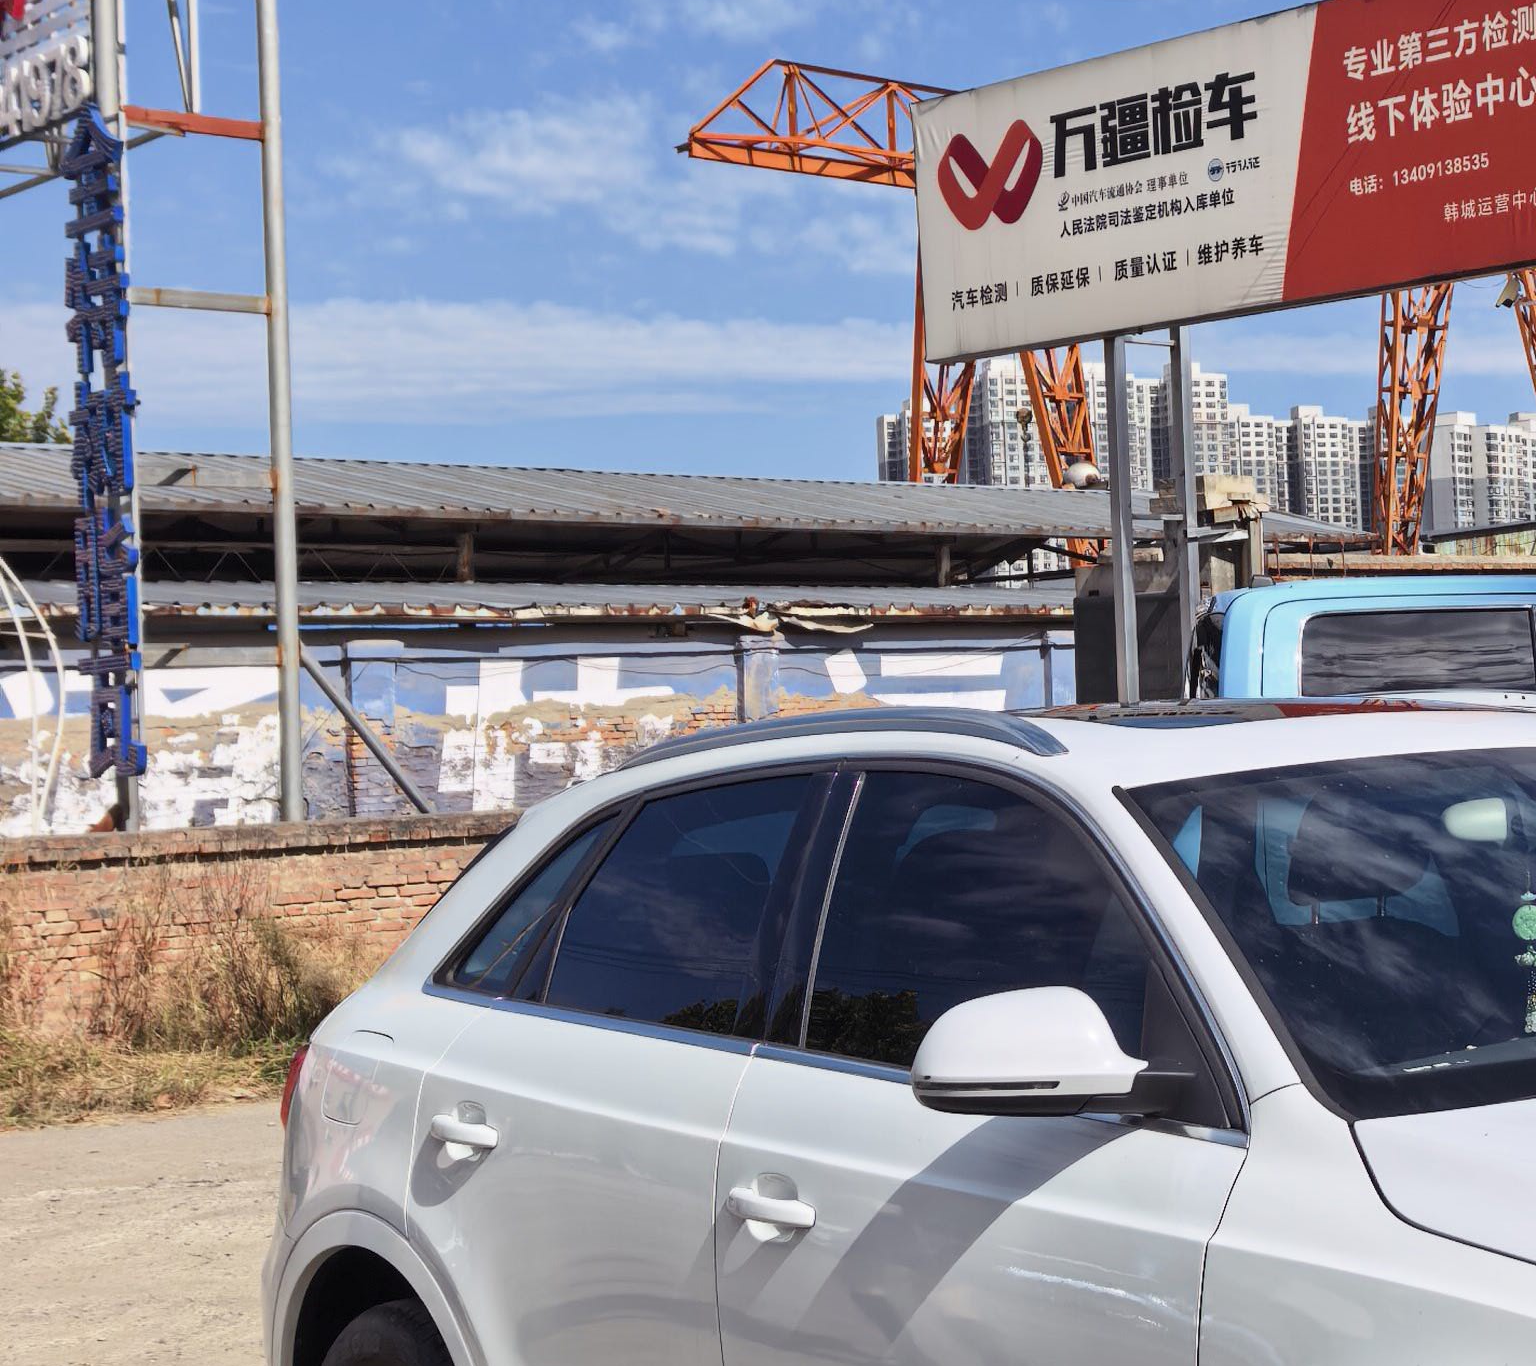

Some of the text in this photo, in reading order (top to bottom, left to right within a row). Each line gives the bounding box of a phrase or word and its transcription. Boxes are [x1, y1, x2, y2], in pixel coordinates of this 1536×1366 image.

[1049, 71, 1258, 178] 万疆检车
[1060, 187, 1236, 238] 人民法院司法鉴定机构入库单位
[1146, 171, 1189, 193] 理事单位
[951, 235, 1265, 312] 汽车检测 质保延保 质量认证 维护养车
